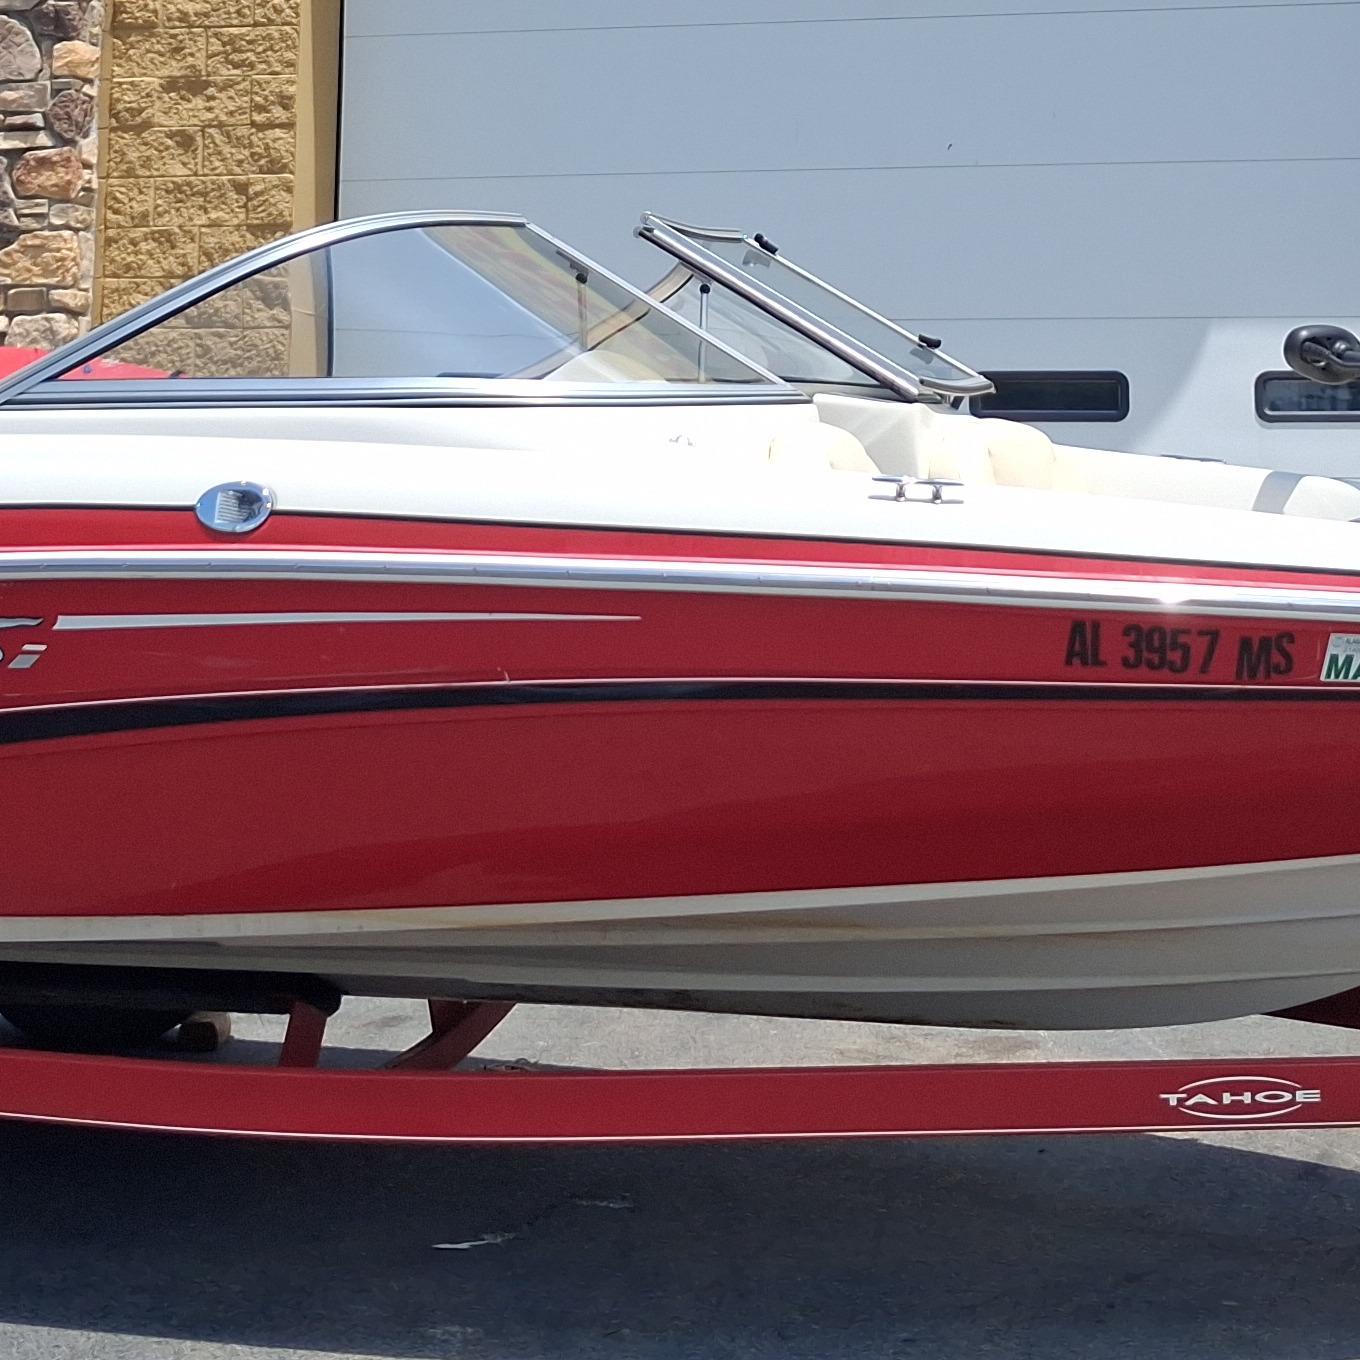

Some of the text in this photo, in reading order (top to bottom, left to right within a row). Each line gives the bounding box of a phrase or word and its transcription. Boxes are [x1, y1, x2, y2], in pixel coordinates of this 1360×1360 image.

[1064, 619, 1297, 681] AL 3957 MS
[1158, 1089, 1322, 1107] TAHOE
